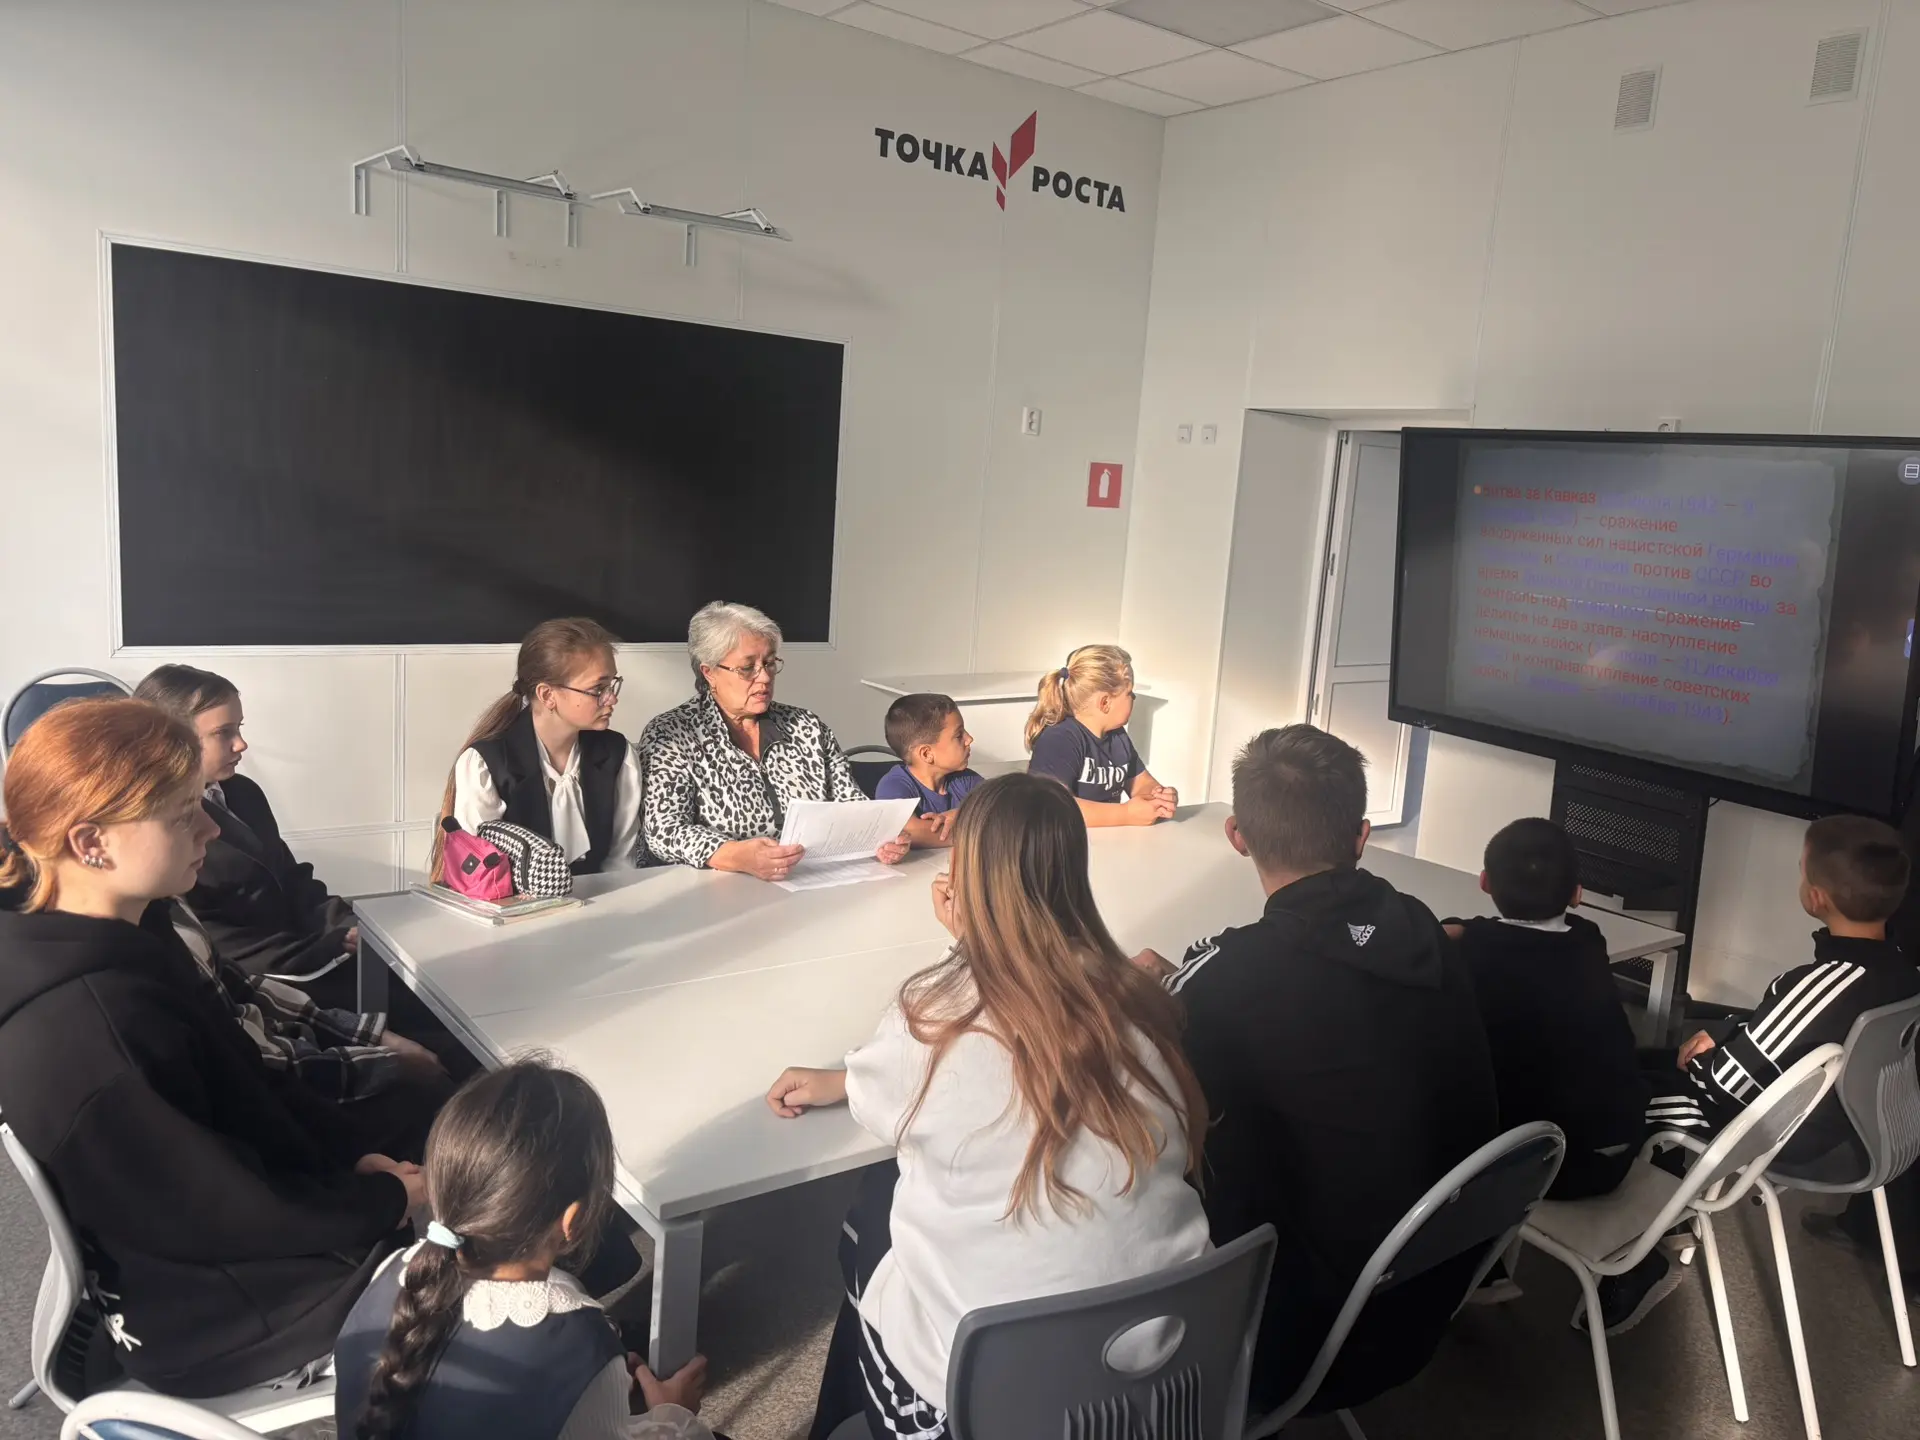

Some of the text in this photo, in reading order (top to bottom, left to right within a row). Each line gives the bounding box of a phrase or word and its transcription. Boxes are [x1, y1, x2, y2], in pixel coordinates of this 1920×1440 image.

[875, 127, 1126, 213] ТОЧКА РОСТА
[1545, 487, 1596, 504] Кавказ
[1599, 514, 1678, 532] сражение
[1578, 536, 1604, 549] сил
[1609, 539, 1703, 558] нацистской
[1544, 555, 1552, 564] и
[1634, 561, 1691, 581] против
[1750, 574, 1772, 588] во
[1542, 592, 1567, 610] над
[1655, 606, 1741, 633] Сражение
[1776, 602, 1796, 615] за
[1551, 616, 1578, 631] два
[1632, 629, 1738, 655] наступление
[1663, 675, 1751, 703] советских
